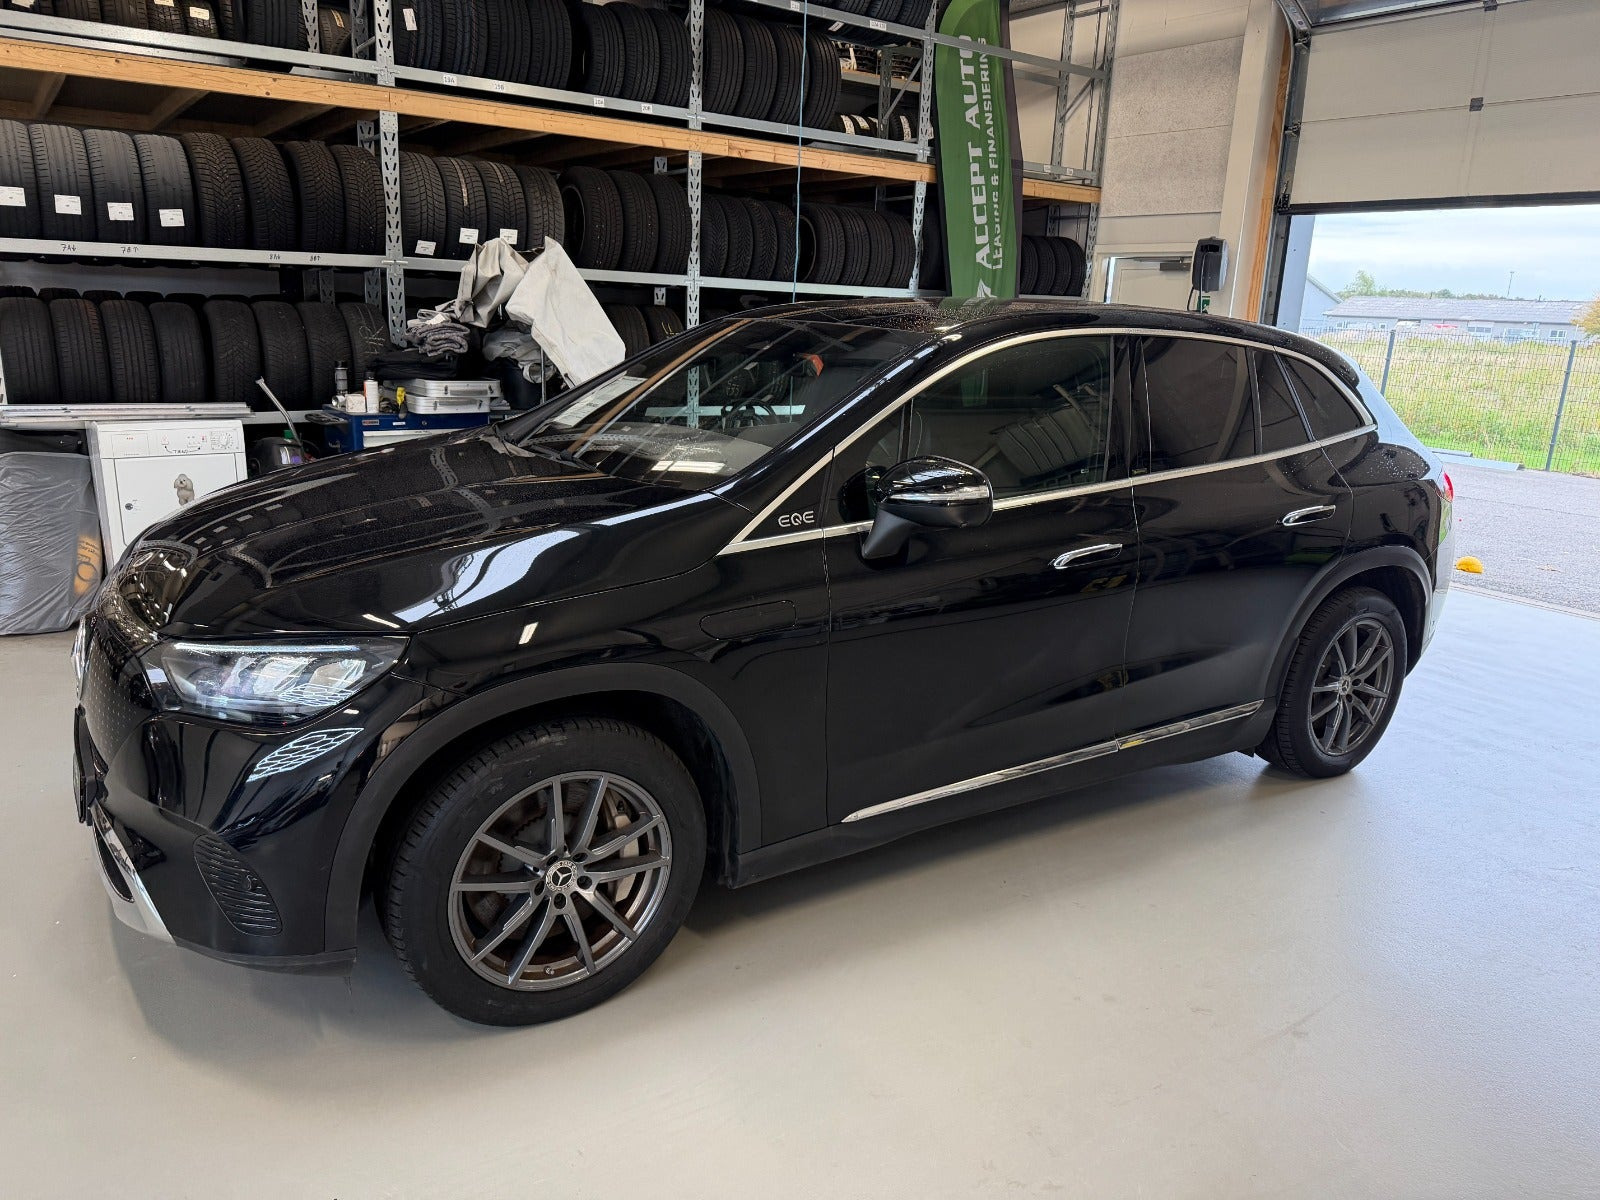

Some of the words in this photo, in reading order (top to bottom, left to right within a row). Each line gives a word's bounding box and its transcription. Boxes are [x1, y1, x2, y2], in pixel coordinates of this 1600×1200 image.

[959, 35, 980, 129] AUTO
[968, 141, 993, 269] ACCEPT
[991, 173, 999, 186] &
[778, 510, 815, 528] EQE
